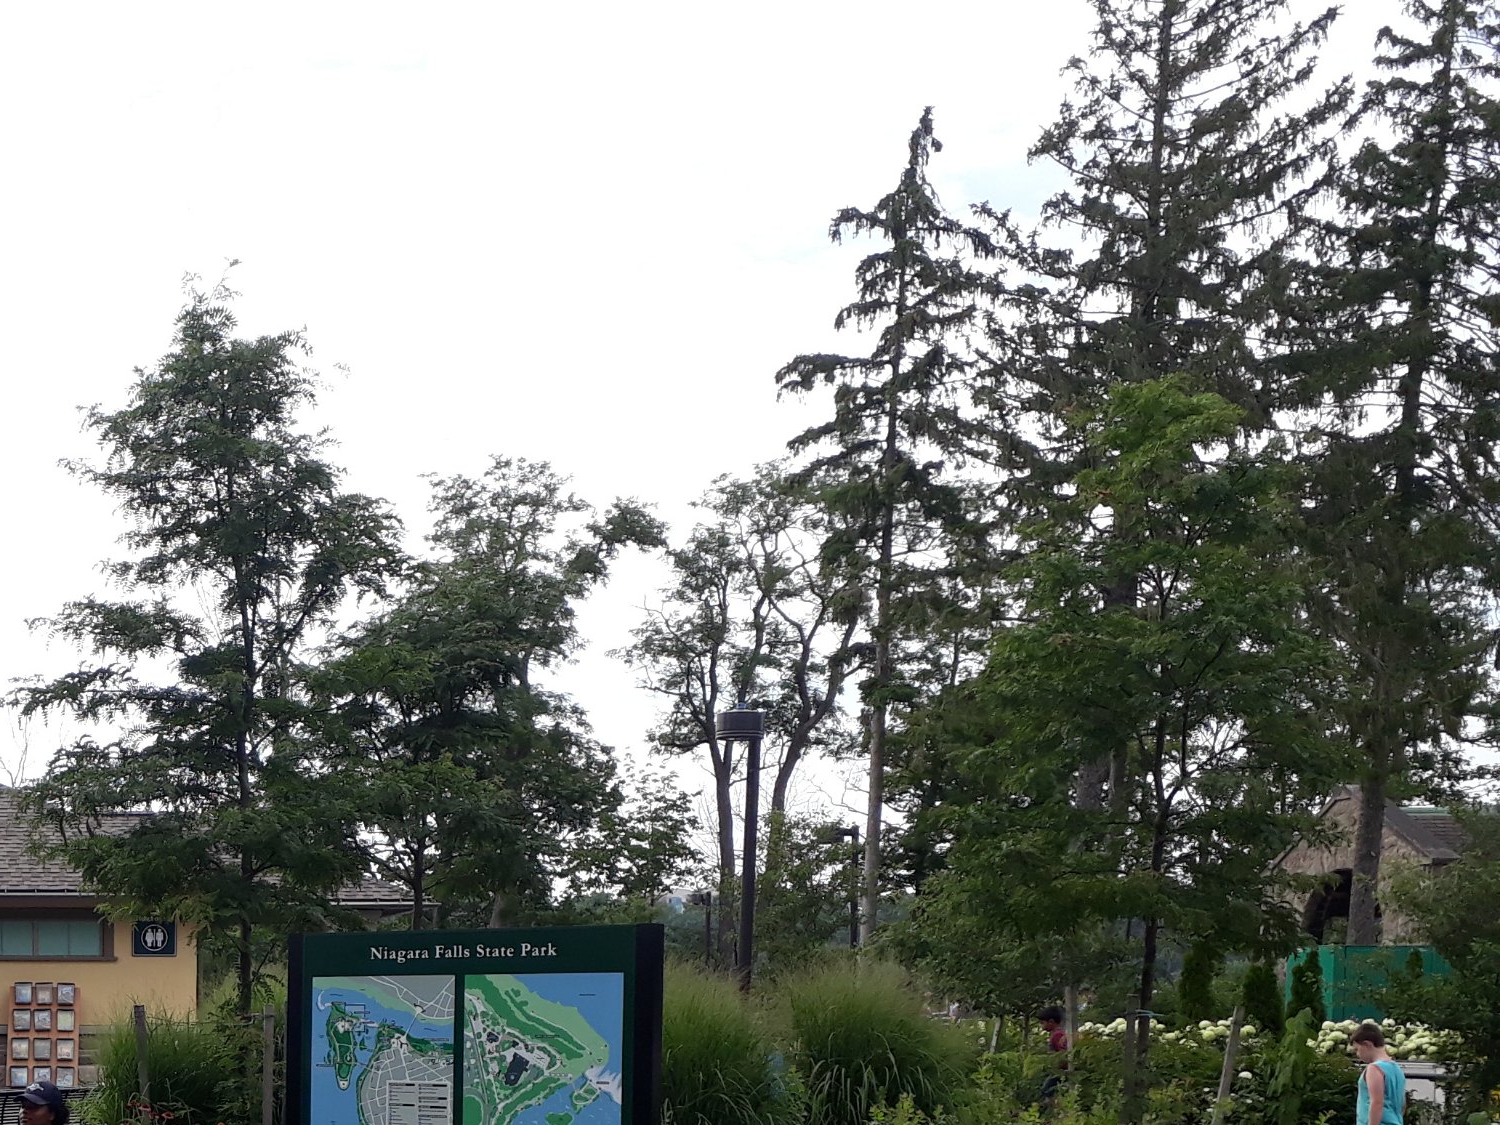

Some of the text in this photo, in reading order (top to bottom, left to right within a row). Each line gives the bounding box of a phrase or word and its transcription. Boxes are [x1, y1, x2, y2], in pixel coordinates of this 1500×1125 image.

[369, 942, 558, 964] Niagara Falls State Park
